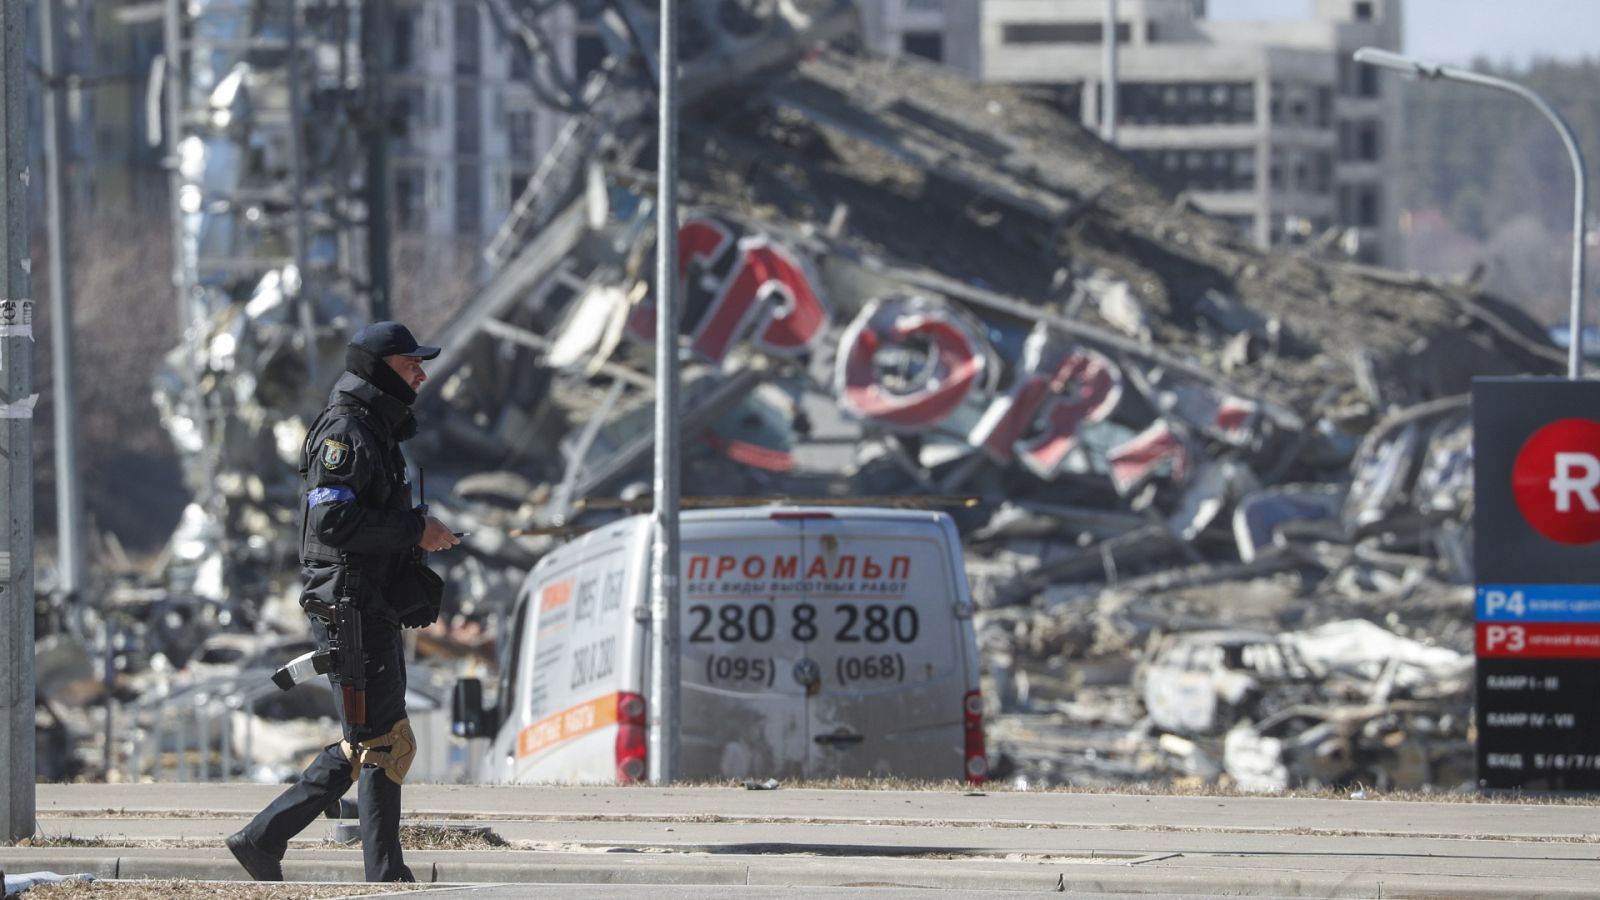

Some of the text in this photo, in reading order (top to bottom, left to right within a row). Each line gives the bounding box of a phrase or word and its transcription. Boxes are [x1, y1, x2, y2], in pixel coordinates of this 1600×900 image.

[687, 555, 912, 580] ПРОМАЛЬП
[687, 582, 716, 593] ВСЕ
[721, 582, 765, 595] ВИДЫ
[860, 582, 908, 593] РАБОТ
[1486, 591, 1525, 615] P4
[688, 603, 919, 644] 280 8 280
[1486, 626, 1525, 651] P3
[706, 653, 776, 687] (095)
[836, 652, 905, 687] (068)
[1487, 675, 1528, 689] RAMP
[1487, 712, 1528, 727] RAMP
